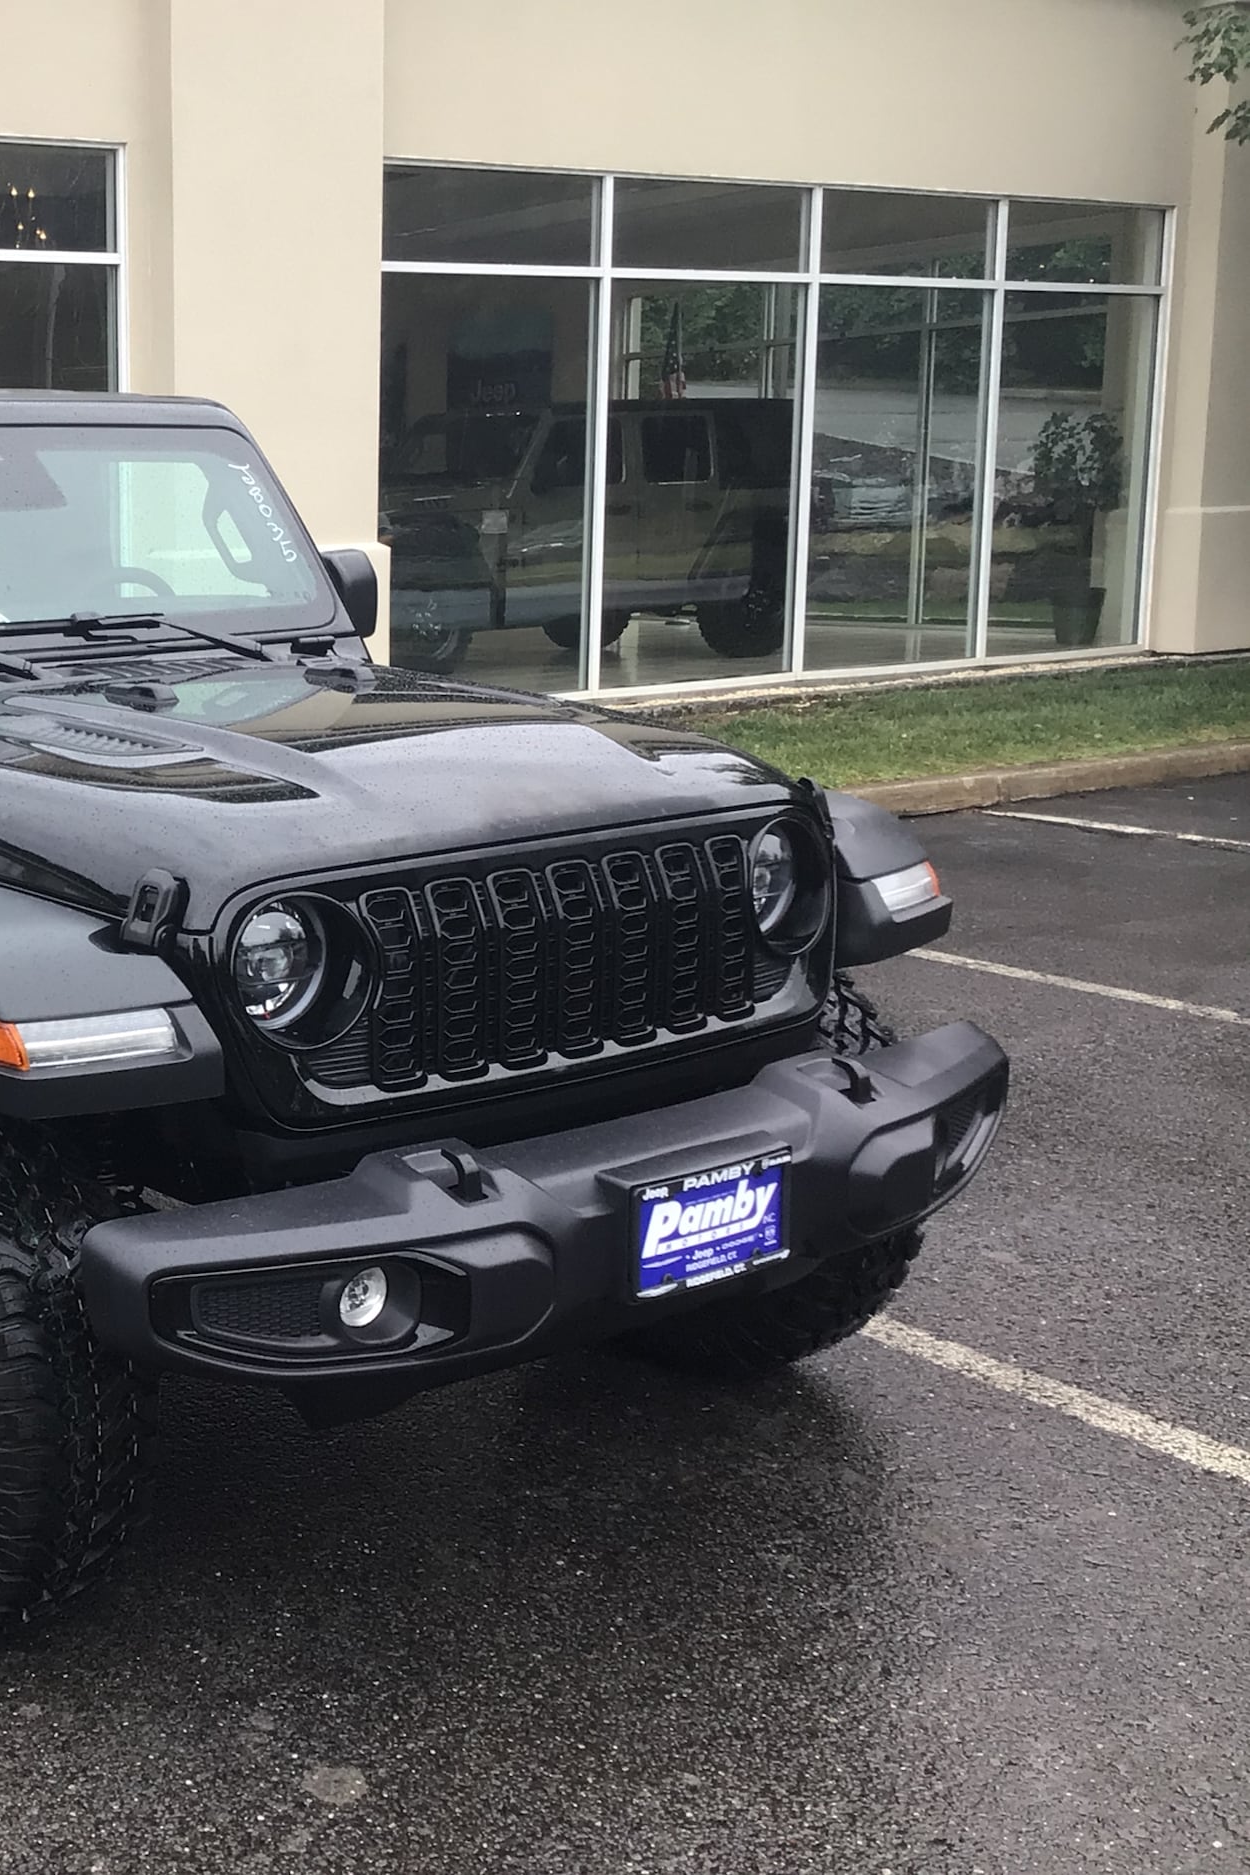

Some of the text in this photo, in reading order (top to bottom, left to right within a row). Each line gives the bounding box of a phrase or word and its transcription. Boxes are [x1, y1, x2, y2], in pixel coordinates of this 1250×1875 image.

[683, 1162, 755, 1191] PAMBY
[643, 1187, 669, 1201] Jeep
[641, 1179, 778, 1259] Pamby
[692, 1248, 714, 1260] Jeep
